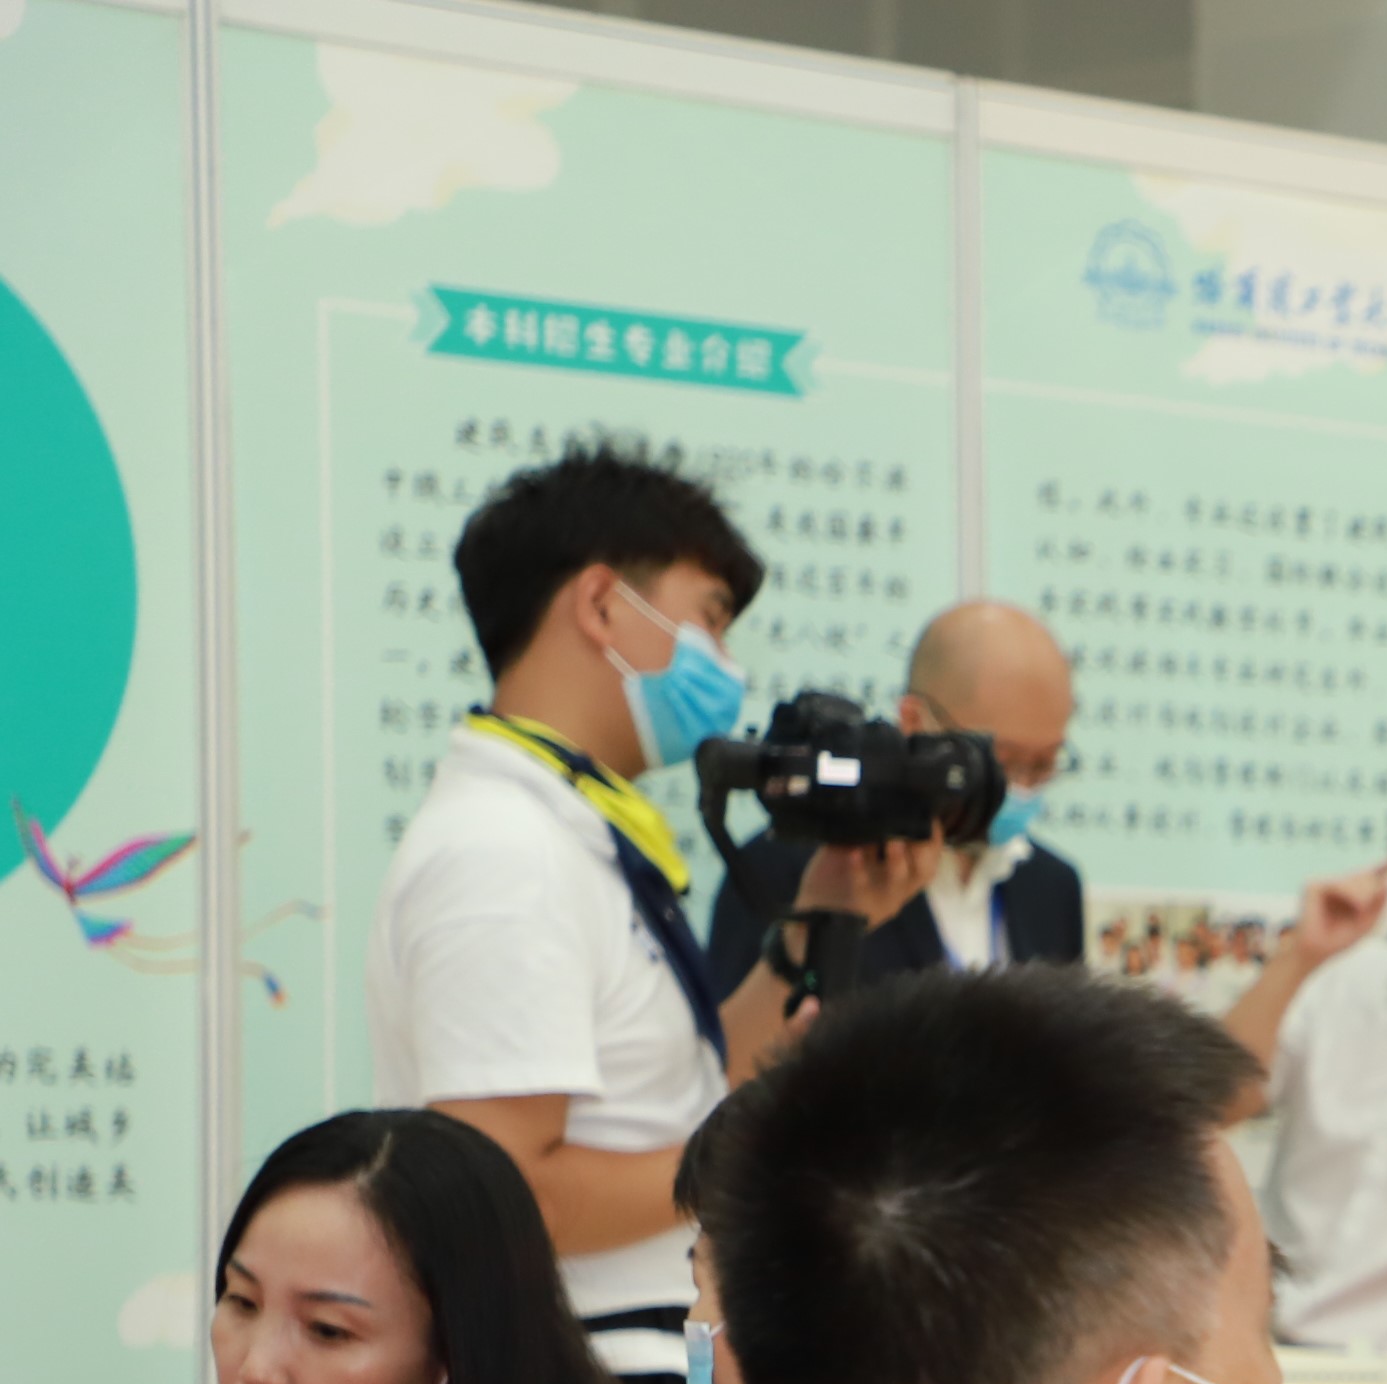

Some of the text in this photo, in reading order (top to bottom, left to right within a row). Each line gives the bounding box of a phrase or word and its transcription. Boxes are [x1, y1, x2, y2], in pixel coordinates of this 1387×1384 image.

[463, 303, 773, 381] 本科招生专业介绍
